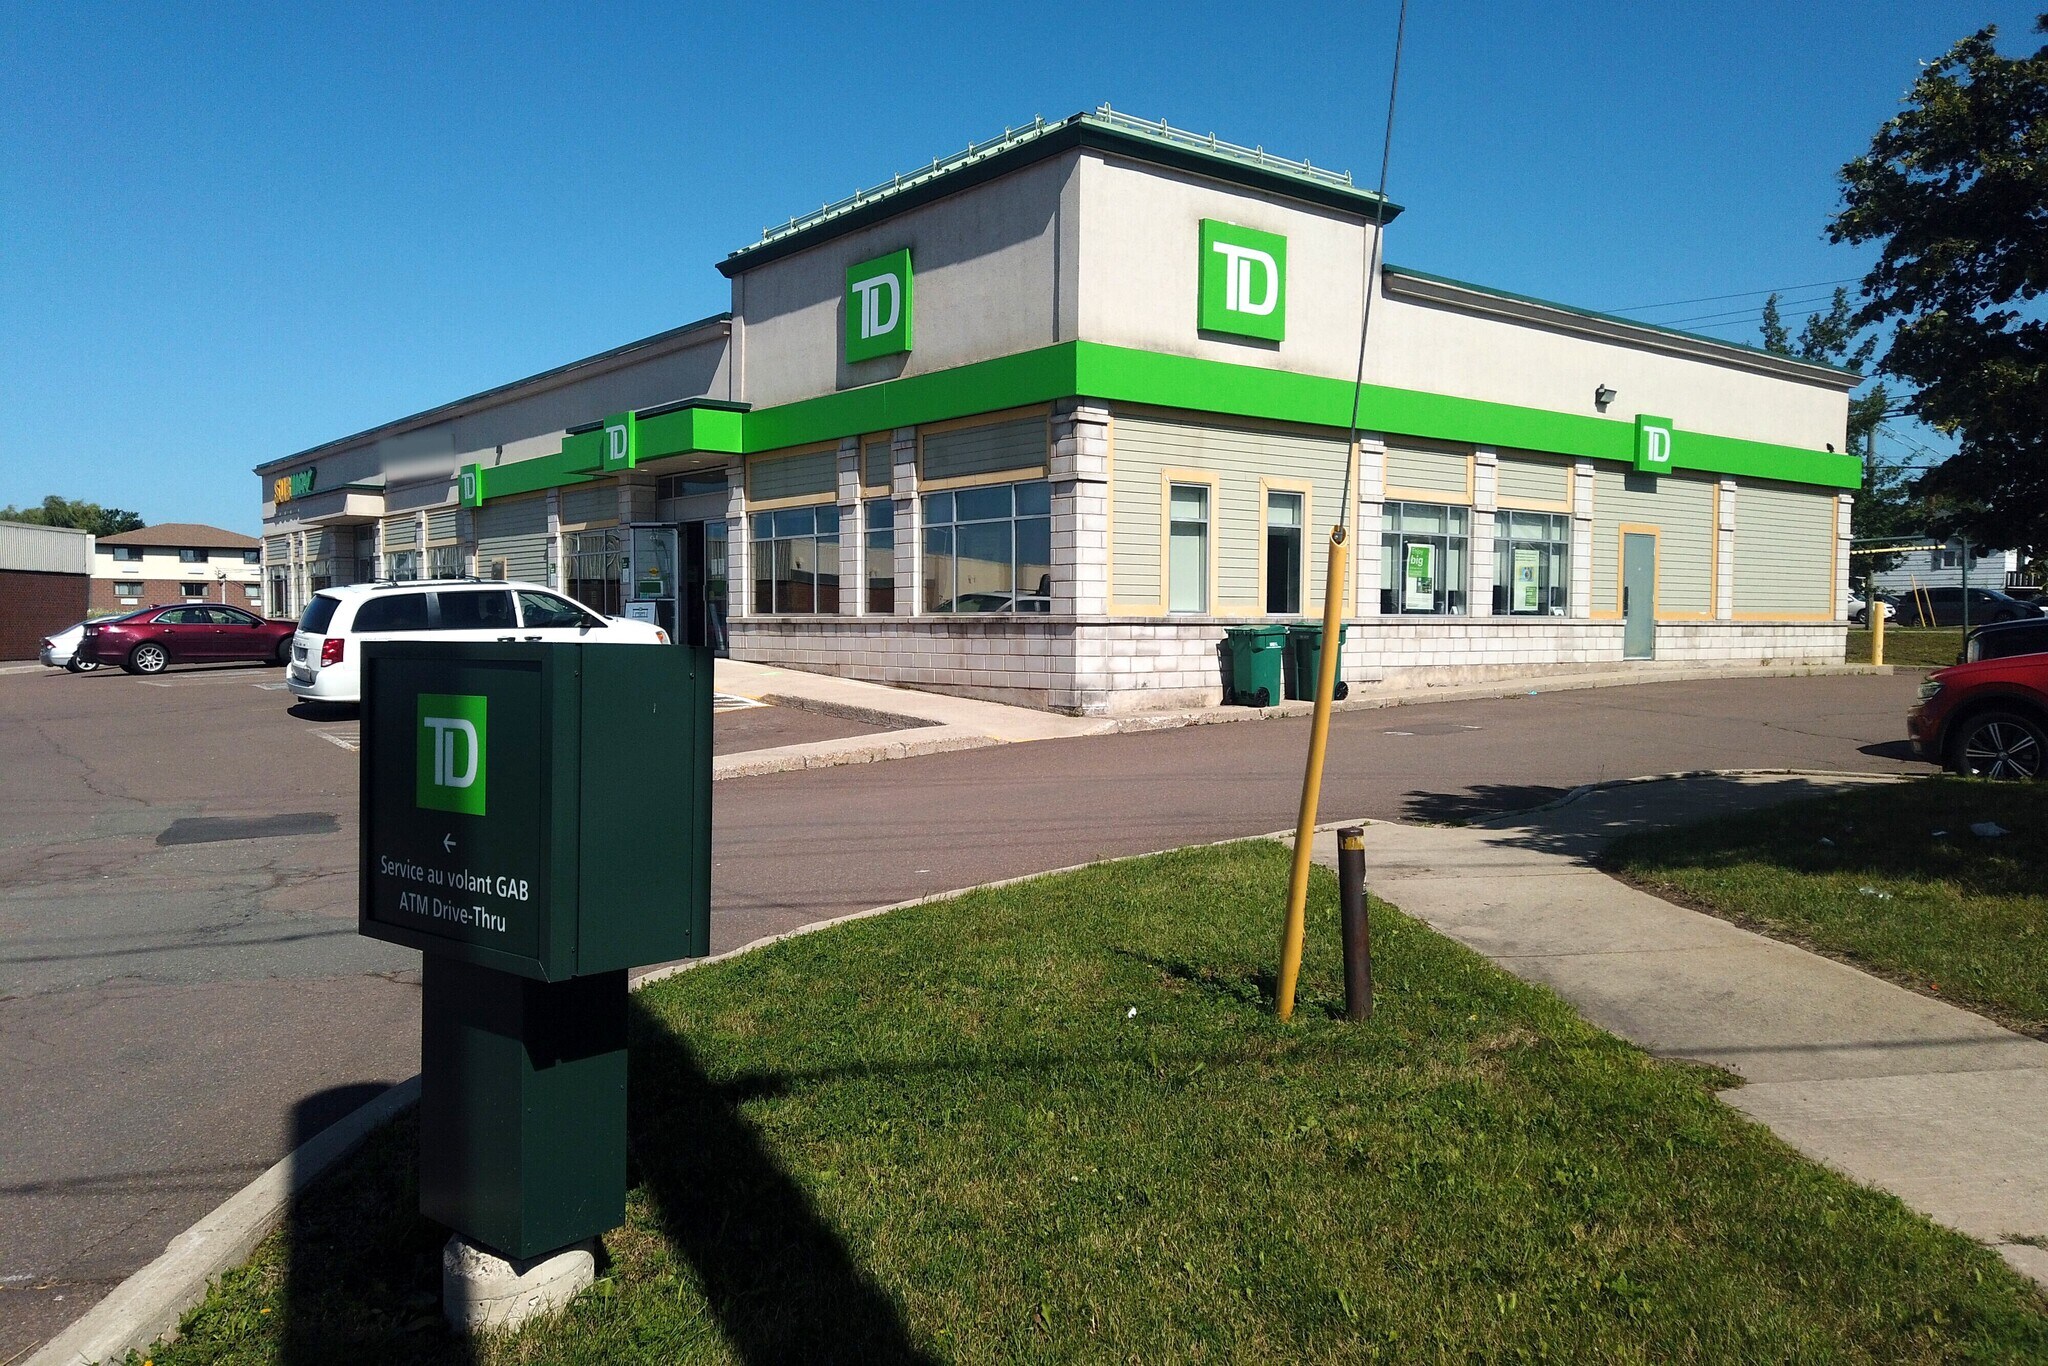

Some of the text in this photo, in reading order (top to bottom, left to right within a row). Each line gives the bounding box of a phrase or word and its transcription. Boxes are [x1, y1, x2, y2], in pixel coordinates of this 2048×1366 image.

[1212, 240, 1279, 316] TD
[852, 272, 900, 339] TD
[605, 424, 628, 460] TD
[1643, 425, 1671, 462] TD
[274, 467, 315, 504] SUBWAY
[462, 472, 476, 499] TD
[1410, 555, 1423, 567] big
[423, 716, 479, 788] TD
[381, 855, 529, 901] Service au volant GAB
[399, 891, 506, 933] ATM Drive-Thru
